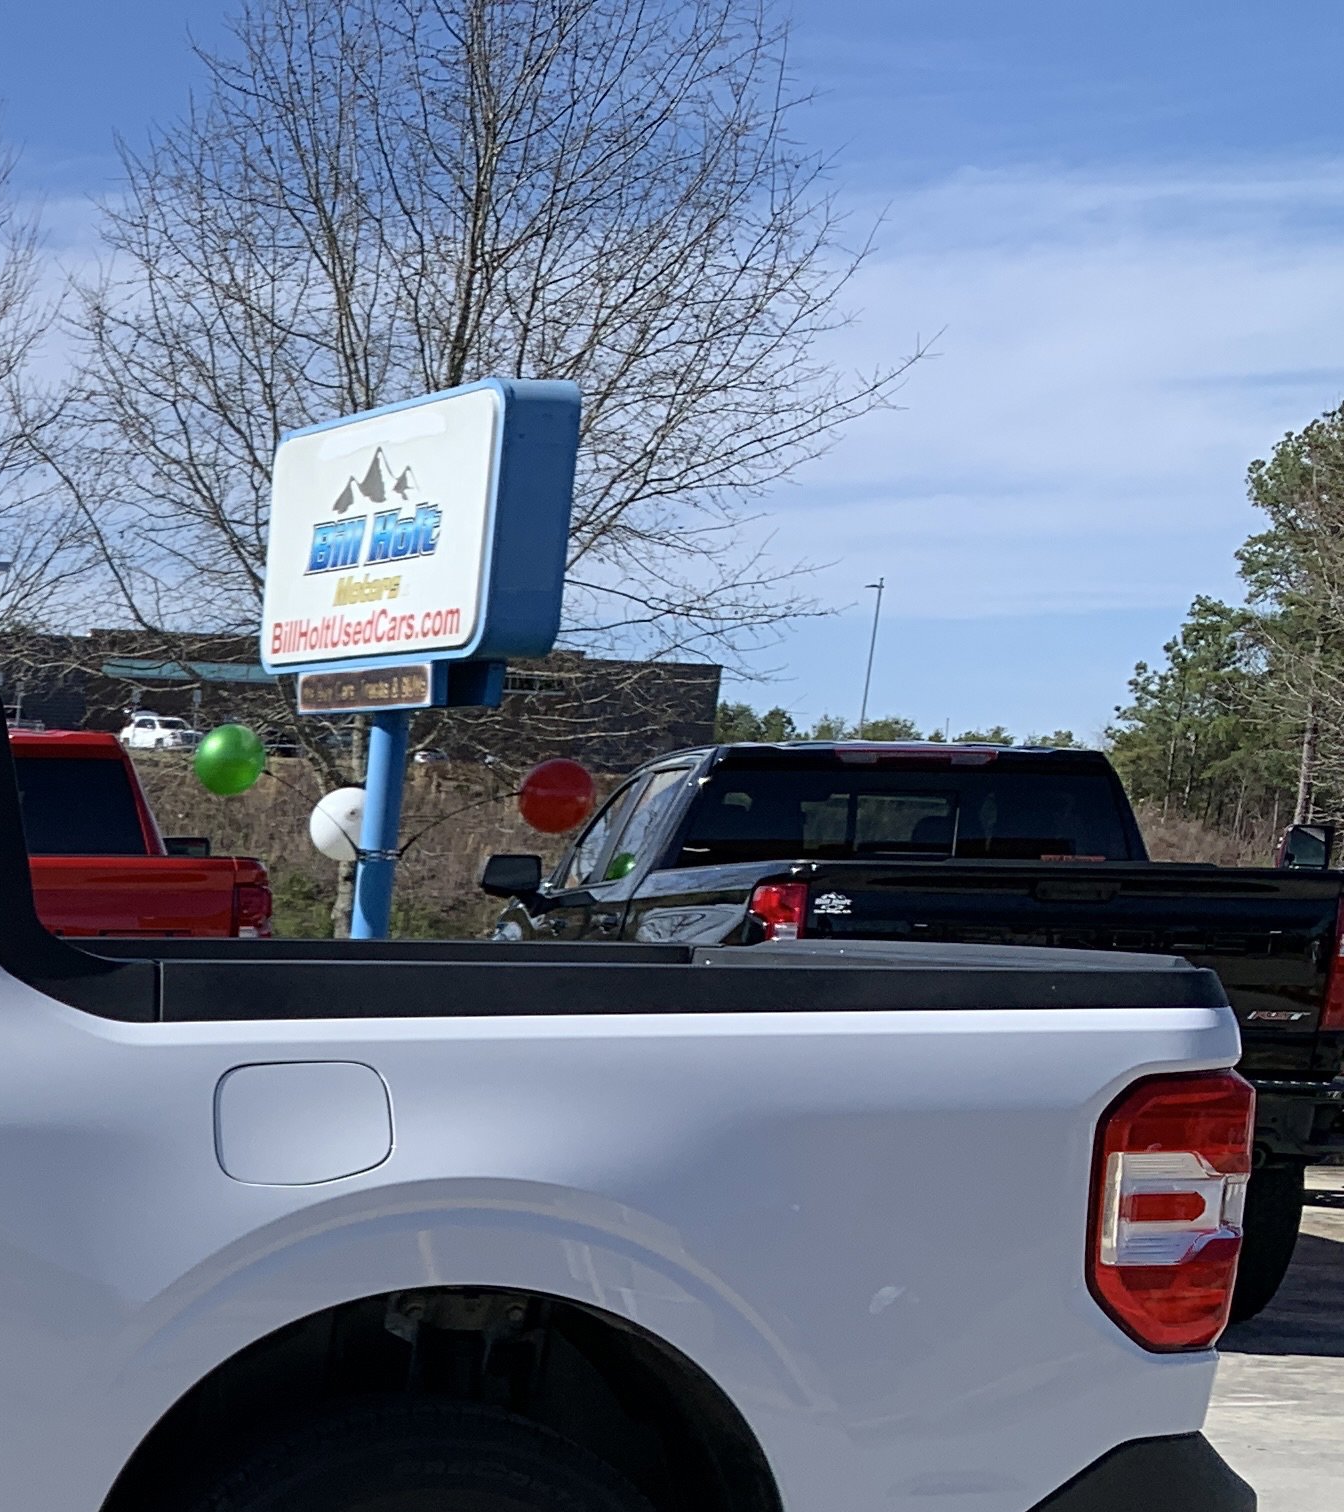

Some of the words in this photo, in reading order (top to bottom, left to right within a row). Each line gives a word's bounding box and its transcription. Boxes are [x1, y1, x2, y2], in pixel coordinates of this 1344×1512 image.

[304, 515, 367, 576] Bill
[364, 502, 443, 566] Holt
[332, 573, 402, 607] Motors
[271, 607, 461, 656] BillHoltUsedCars.com
